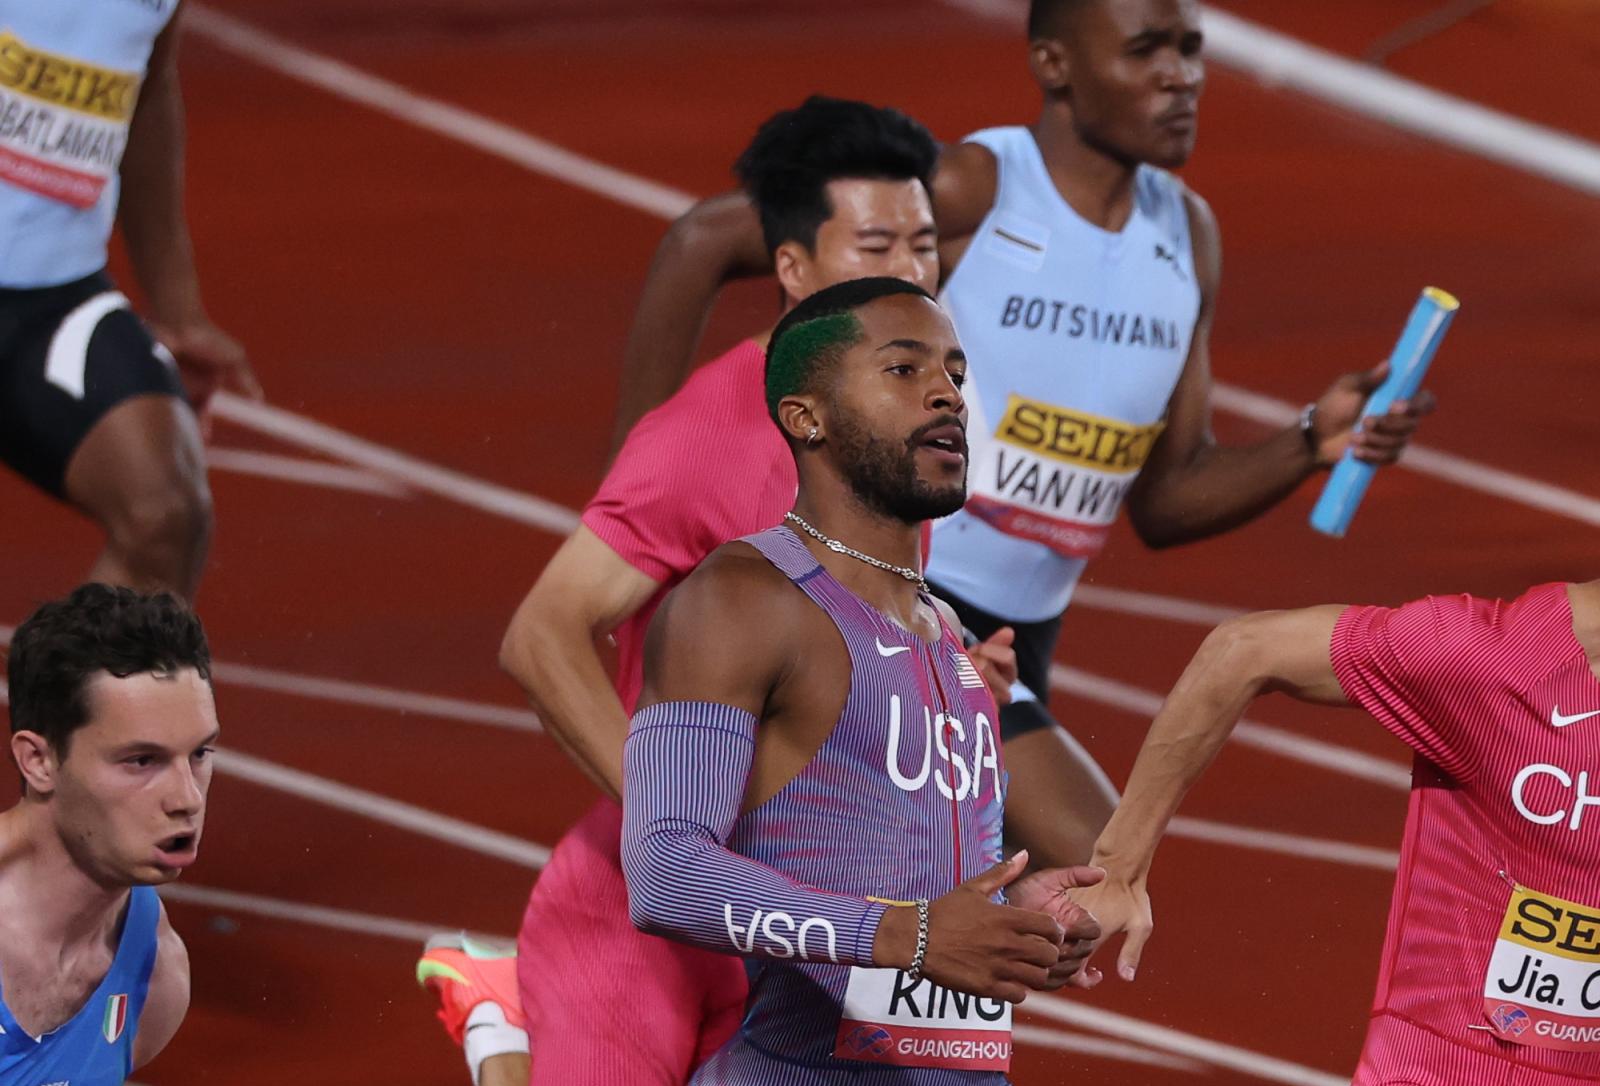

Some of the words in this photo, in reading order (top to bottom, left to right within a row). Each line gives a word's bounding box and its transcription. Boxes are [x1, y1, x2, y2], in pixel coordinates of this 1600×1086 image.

[1000, 295, 1180, 350] BOTSWANA
[996, 450, 1076, 507] VAN
[886, 694, 1001, 803] USA
[724, 903, 839, 963] USA
[1498, 955, 1565, 1006] Jia.
[897, 1037, 1009, 1060] GUANGZHOU
